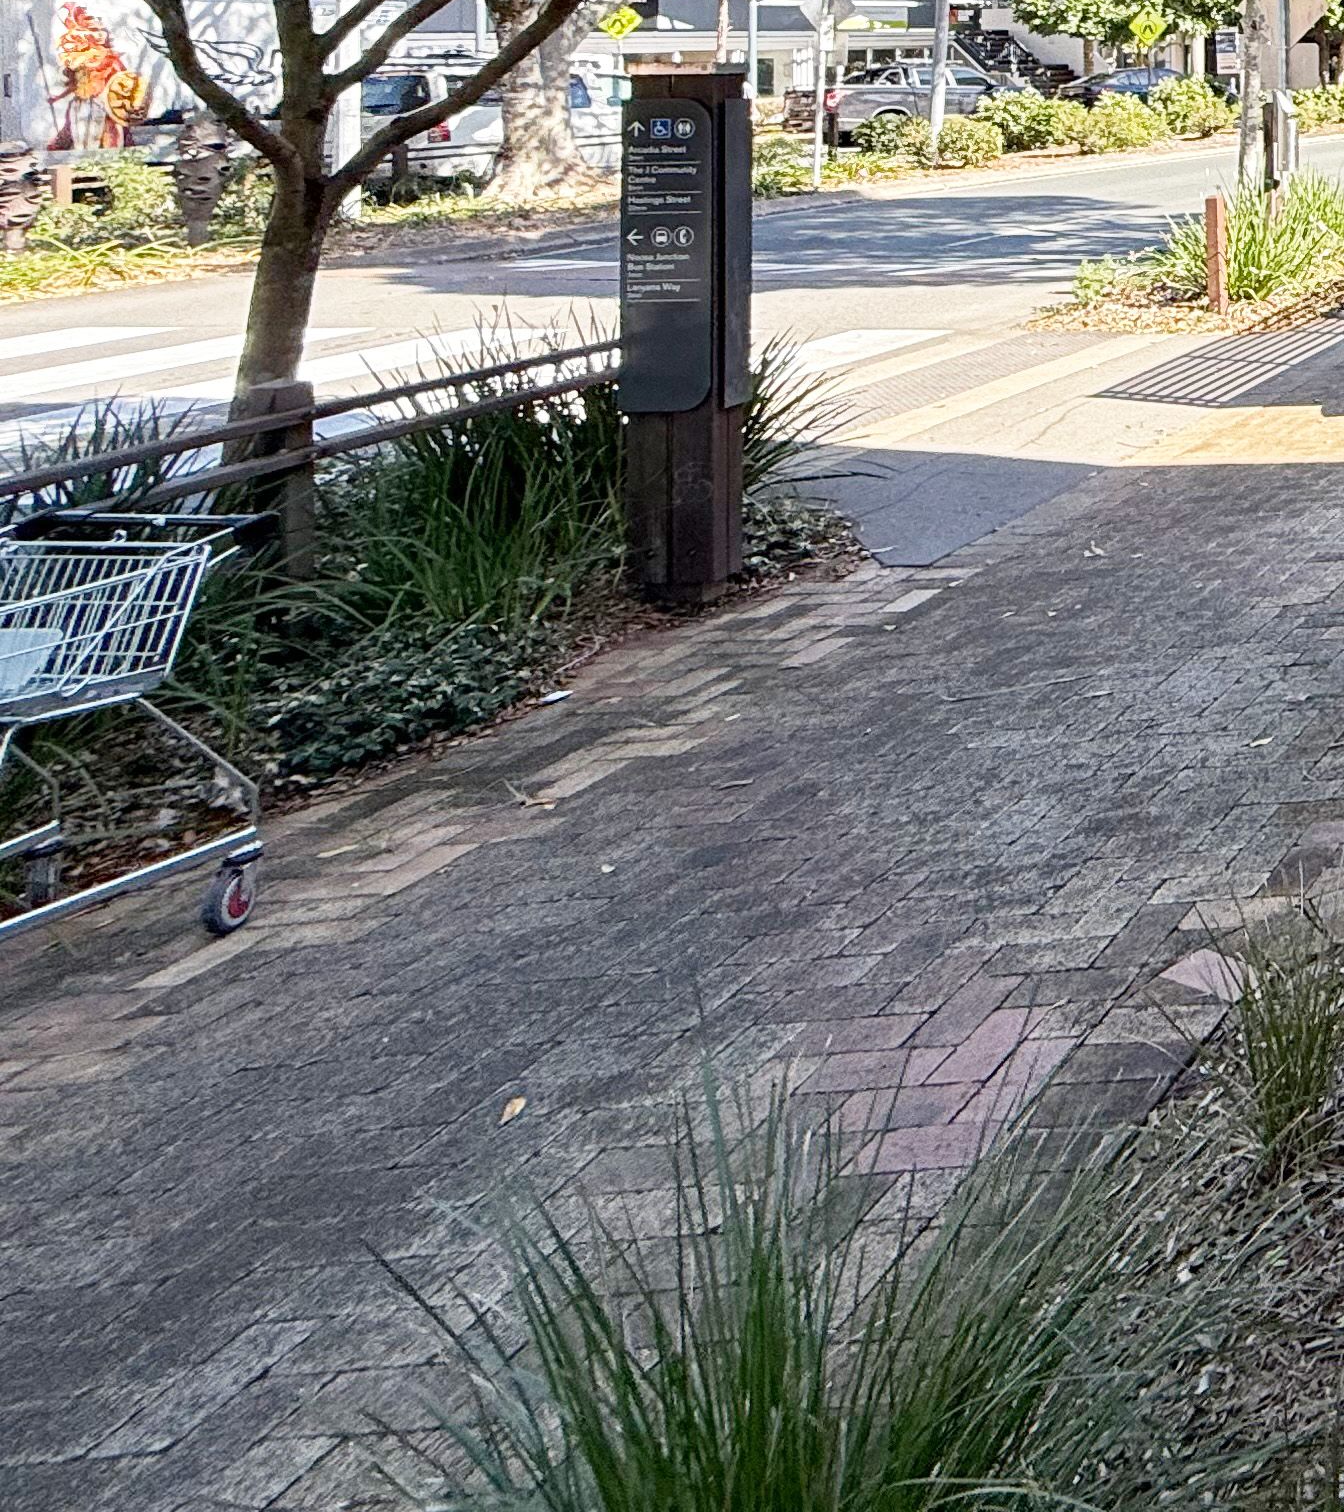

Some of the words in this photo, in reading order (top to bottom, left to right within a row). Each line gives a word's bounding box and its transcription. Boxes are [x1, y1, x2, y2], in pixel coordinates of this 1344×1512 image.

[651, 166, 697, 176] Community
[666, 196, 691, 204] Street
[662, 283, 681, 292] Way
